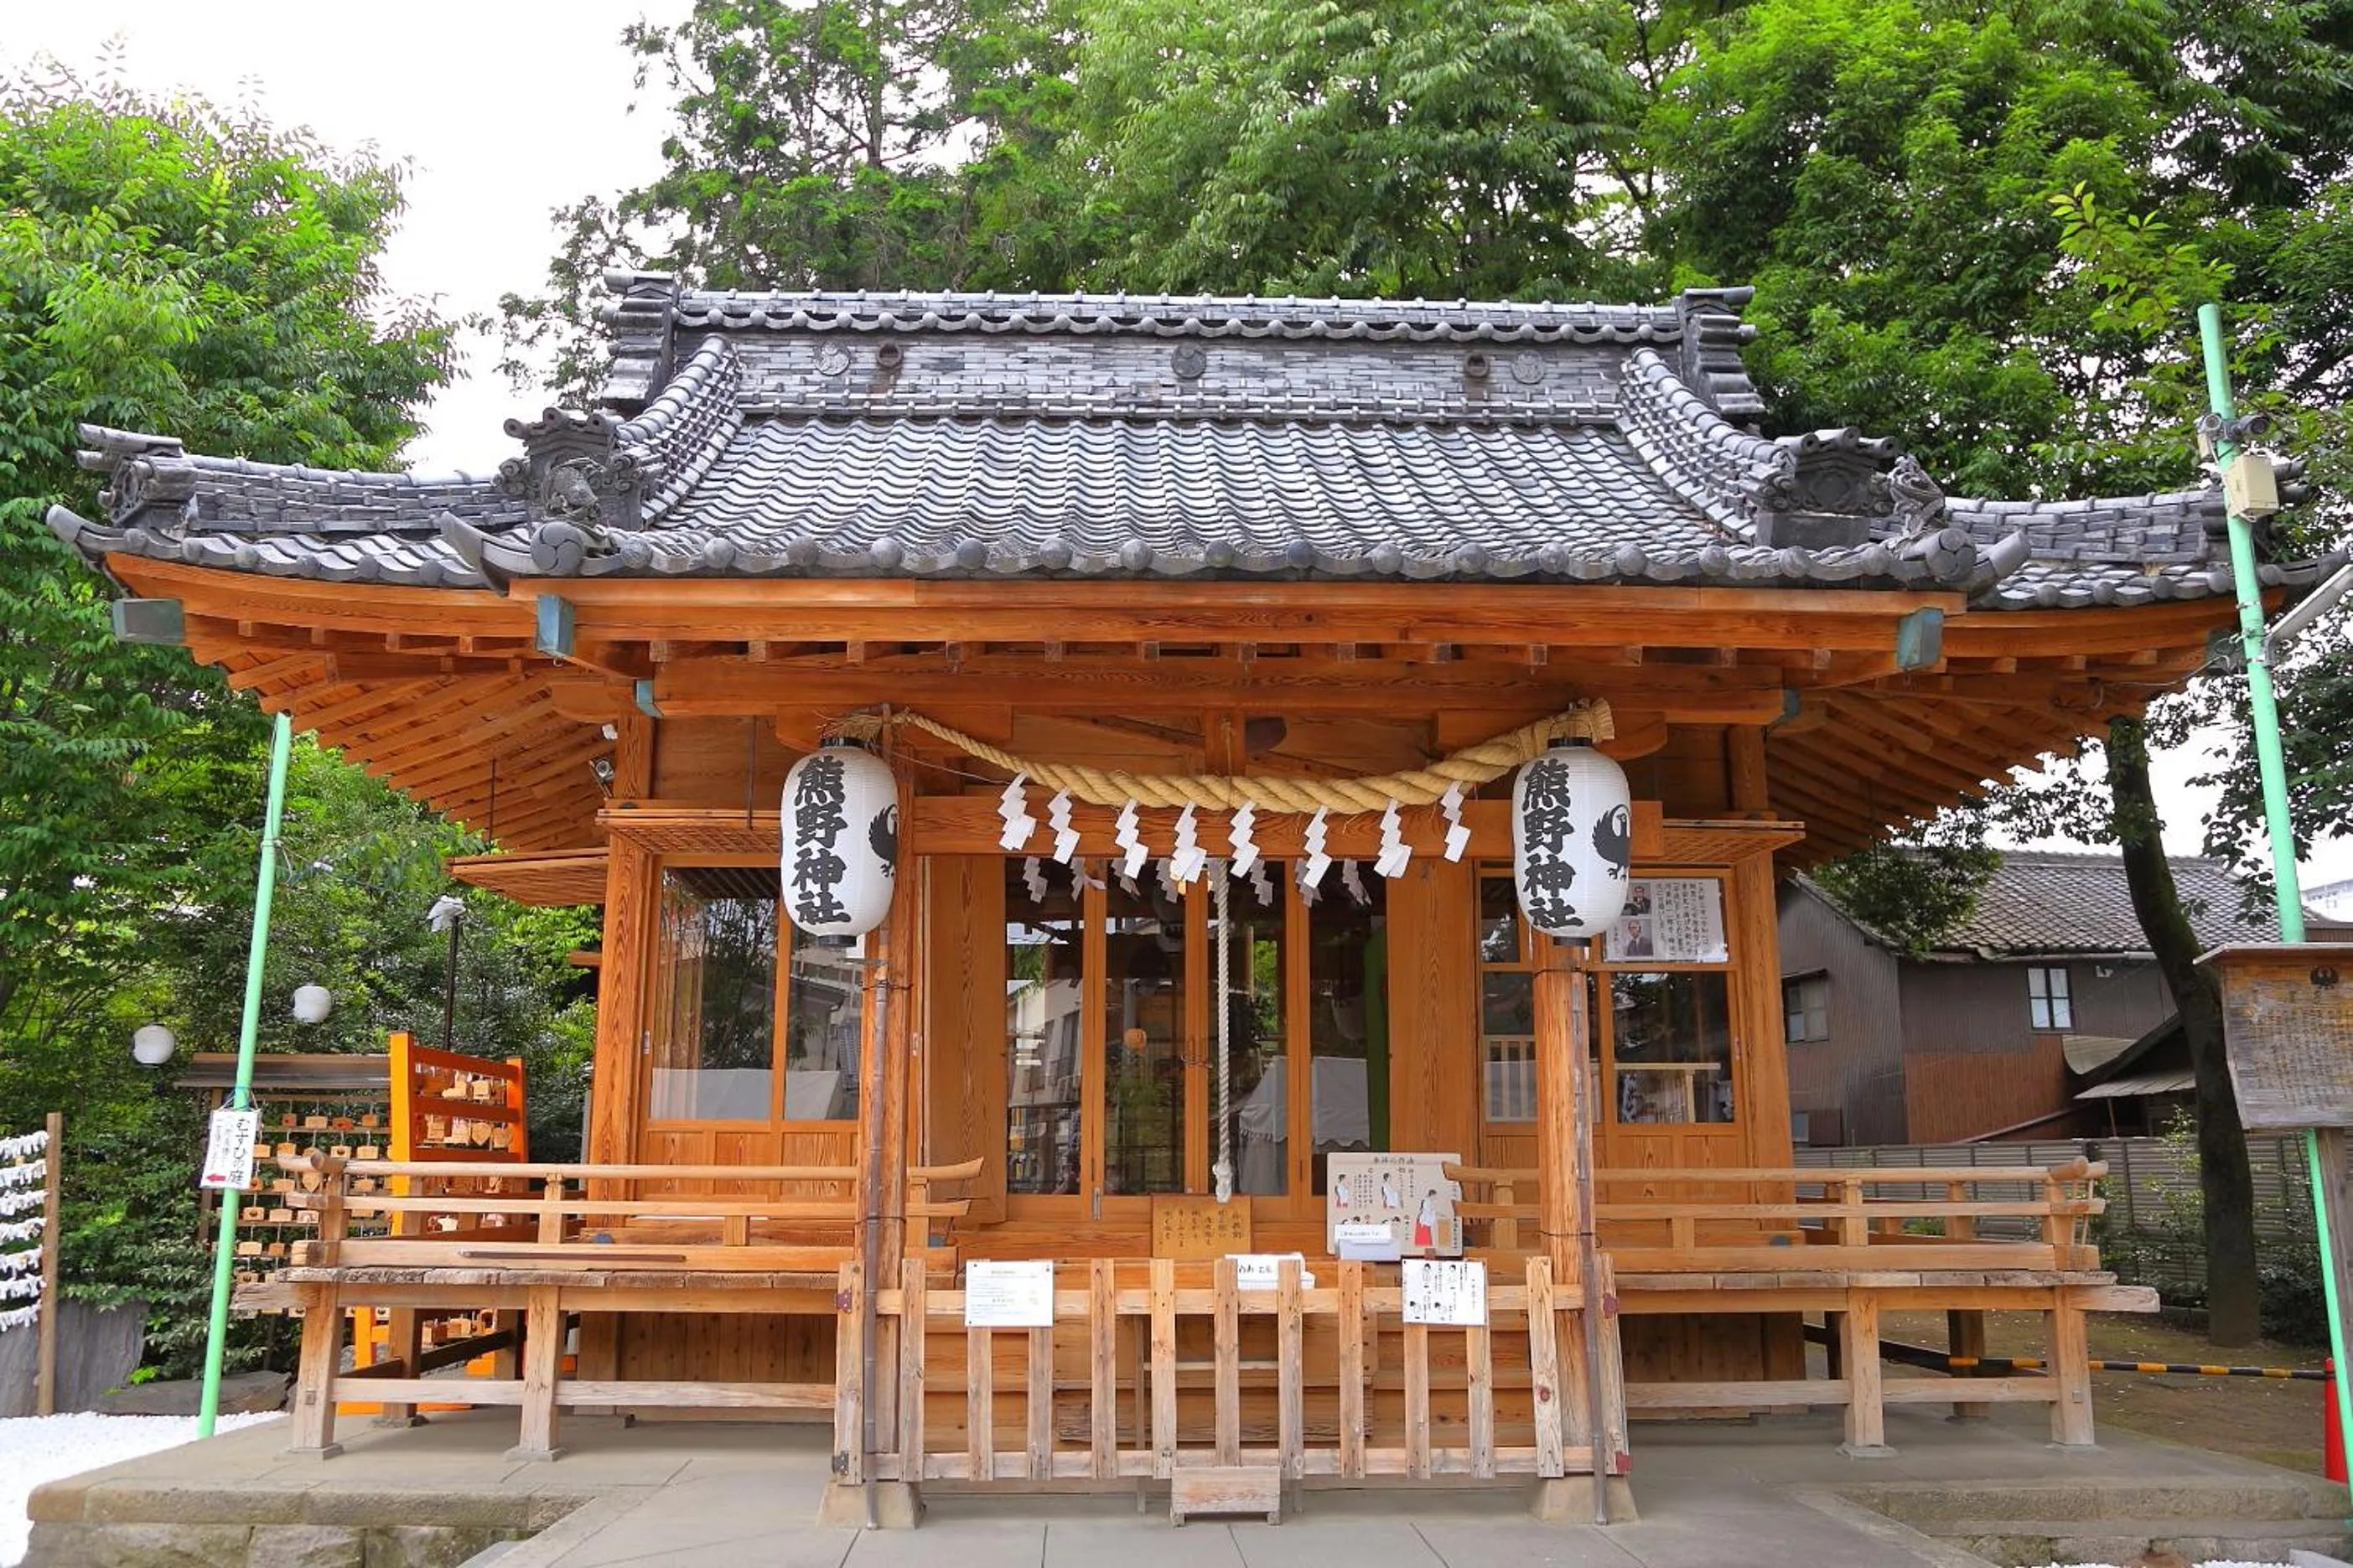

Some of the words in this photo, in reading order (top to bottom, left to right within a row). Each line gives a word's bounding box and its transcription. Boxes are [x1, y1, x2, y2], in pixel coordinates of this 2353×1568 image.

[790, 755, 852, 926] 熊野神社
[1522, 758, 1583, 929] 熊野神社
